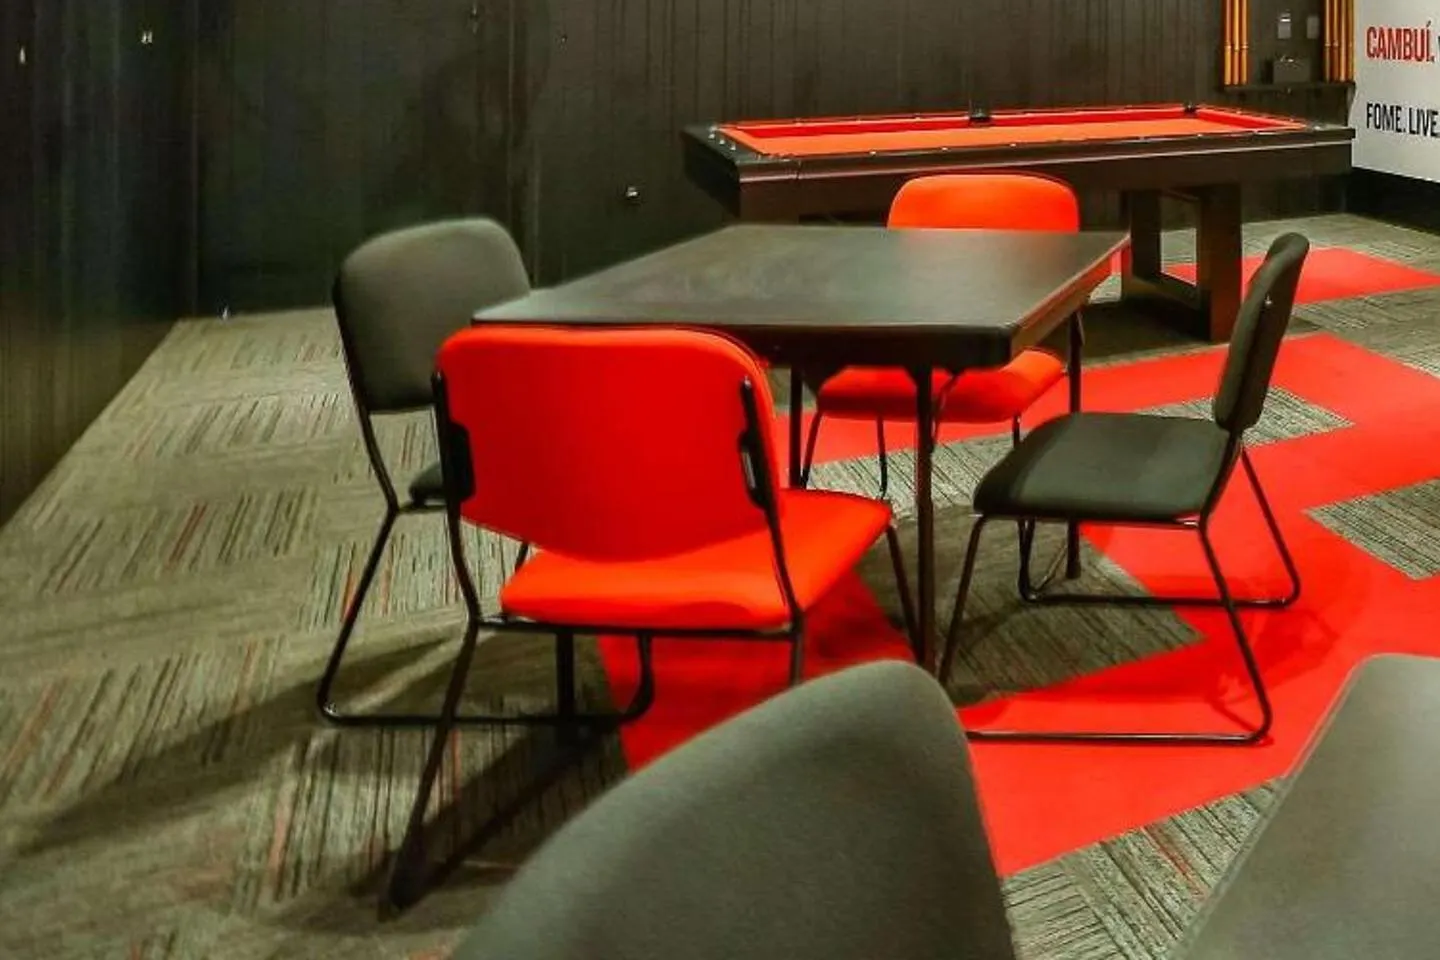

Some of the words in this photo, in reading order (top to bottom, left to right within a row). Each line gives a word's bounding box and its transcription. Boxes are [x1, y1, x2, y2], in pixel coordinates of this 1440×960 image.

[1366, 21, 1435, 63] CAMBUÍ.
[1367, 103, 1405, 132] FOME.
[1409, 108, 1440, 139] LIVE.
